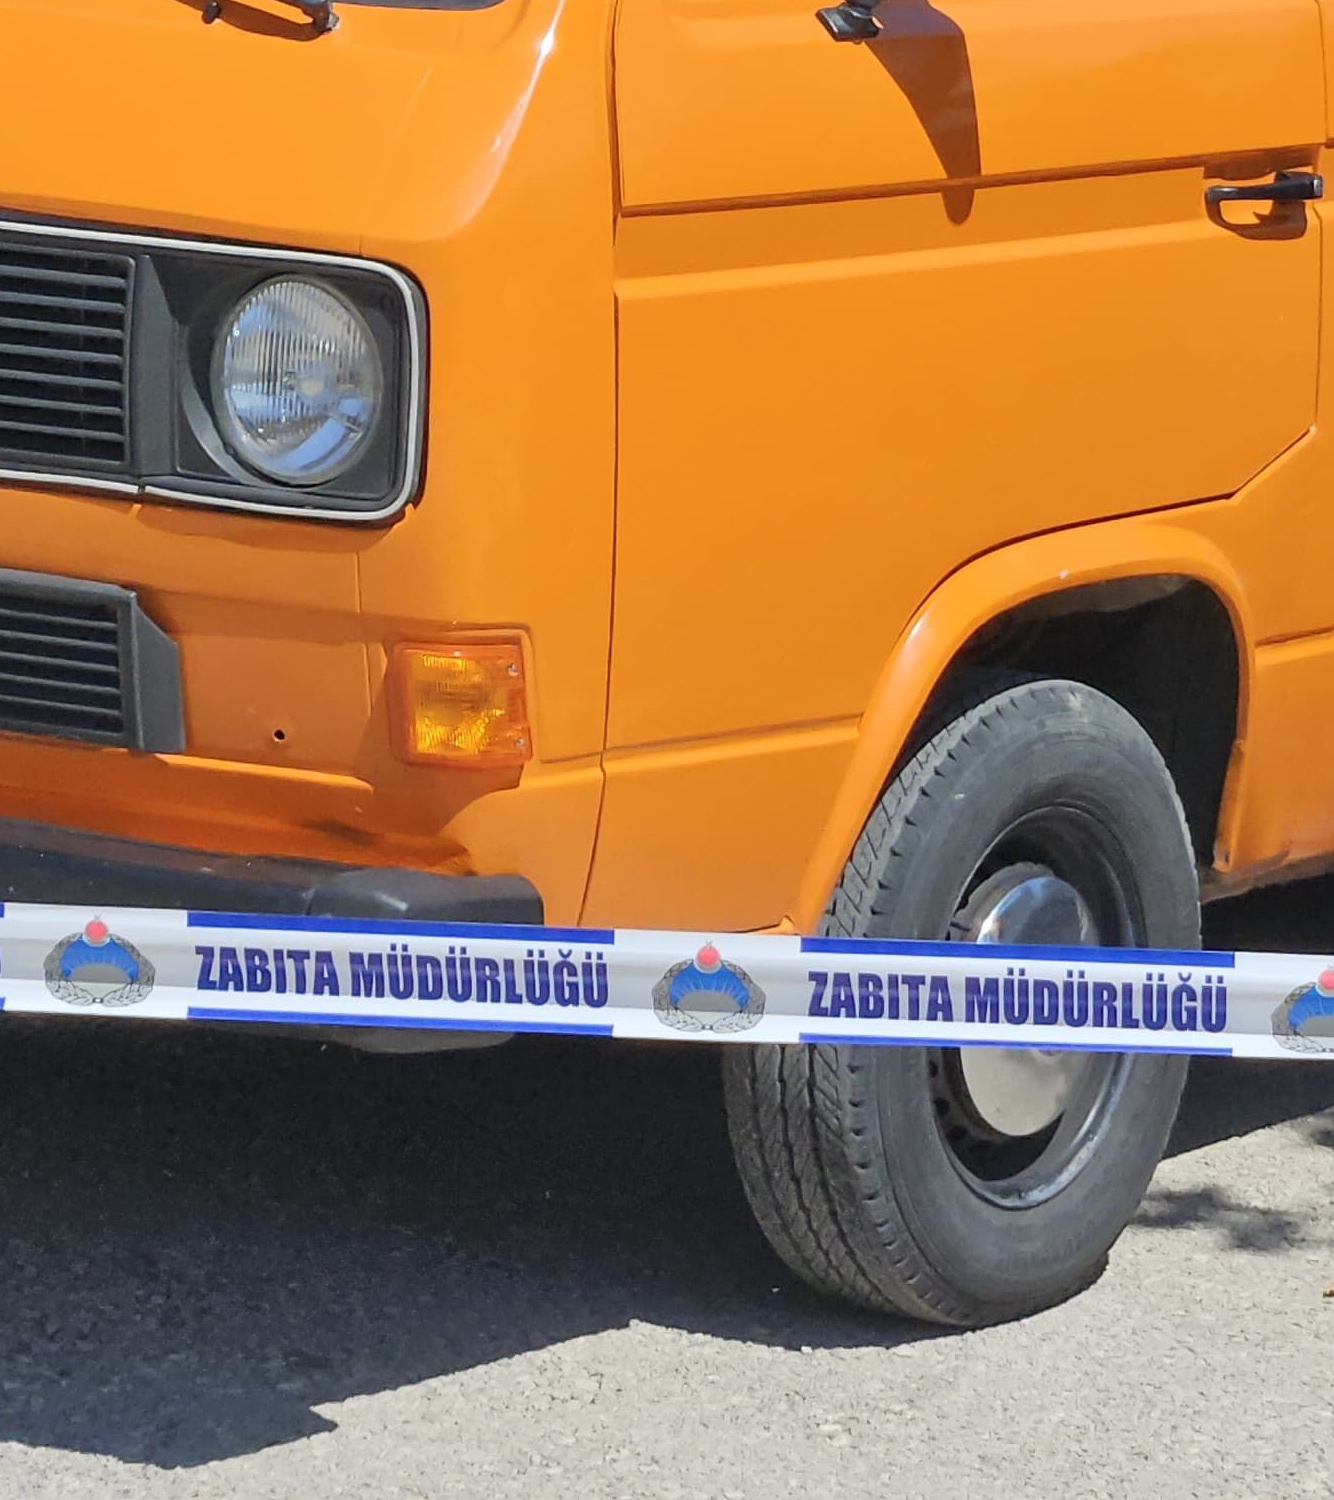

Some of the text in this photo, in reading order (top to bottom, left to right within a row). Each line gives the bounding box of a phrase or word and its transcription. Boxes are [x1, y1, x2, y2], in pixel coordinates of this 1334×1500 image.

[195, 942, 610, 1009] ZABITA MÜDÜRLÜĞÜ
[807, 966, 1229, 1034] ZABITA MÜDÜRLÜĞÜ
